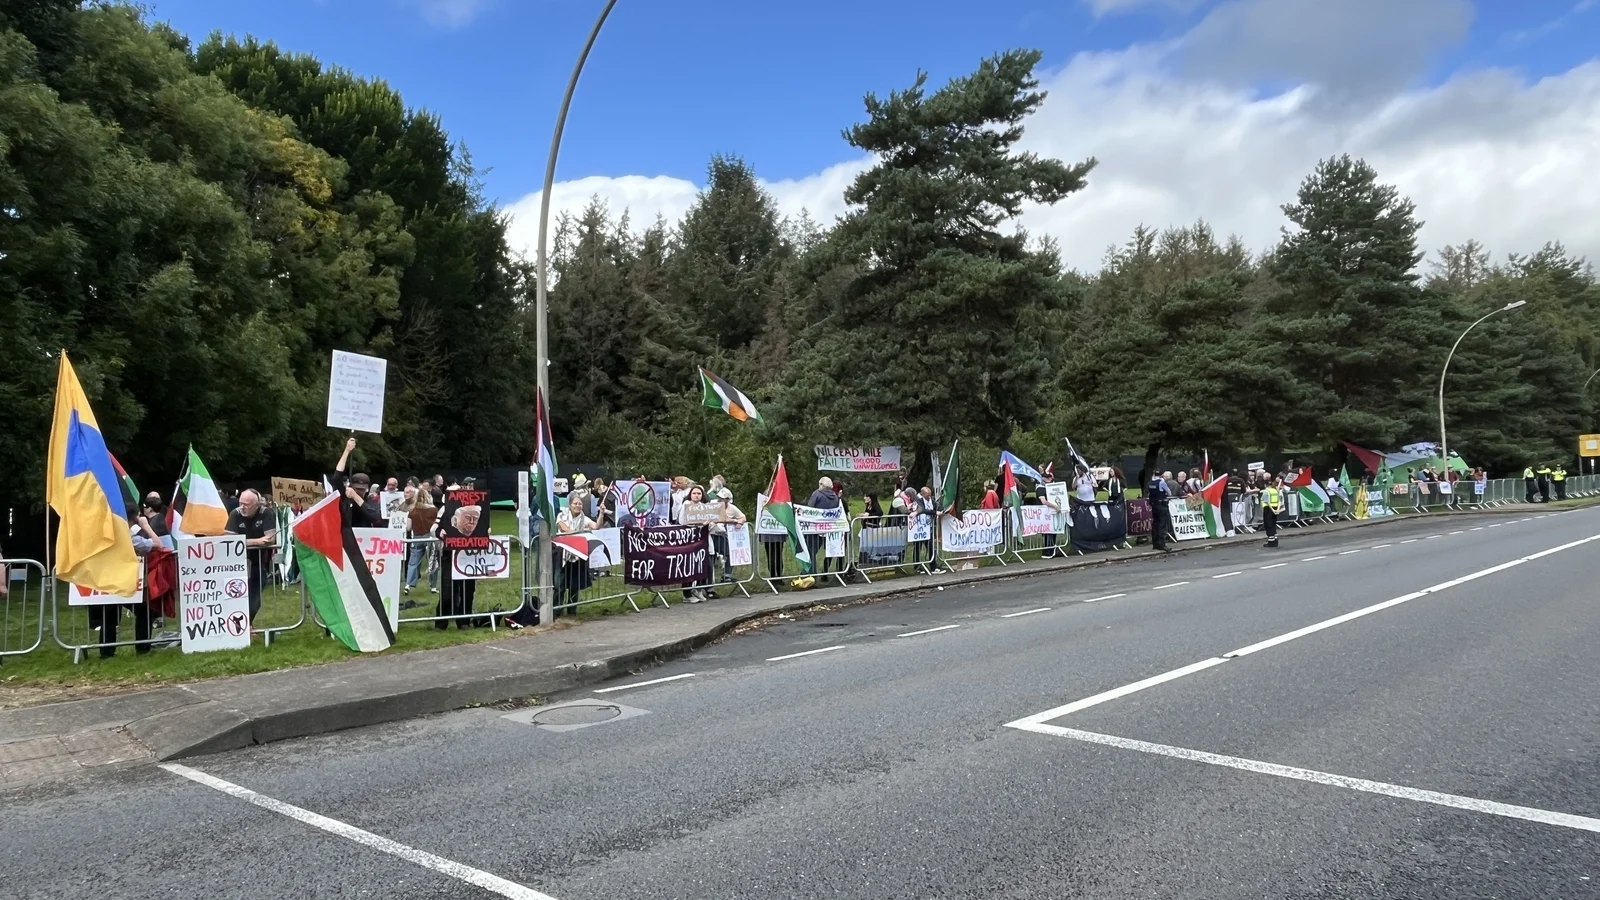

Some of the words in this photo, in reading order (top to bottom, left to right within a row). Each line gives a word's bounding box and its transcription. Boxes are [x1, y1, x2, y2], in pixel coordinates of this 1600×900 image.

[448, 491, 488, 502] ARREST
[1022, 508, 1042, 520] RUMP
[913, 531, 927, 540] one
[1175, 524, 1207, 535] PALESTINE
[445, 536, 489, 548] PREDATOR
[627, 530, 648, 553] NO
[647, 532, 667, 546] RED
[668, 526, 702, 546] CARPET
[187, 541, 215, 561] NO
[220, 540, 245, 557] TO
[181, 566, 197, 576] SEX
[204, 564, 246, 575] OFFENDERS
[464, 564, 498, 577] ONE
[631, 559, 655, 580] FOR
[666, 548, 706, 579] TRUMP
[183, 580, 201, 593] NO
[203, 579, 217, 590] TO
[183, 590, 223, 605] TRUMP
[186, 606, 204, 623] NO
[206, 603, 223, 617] TO
[186, 617, 227, 641] WAR
